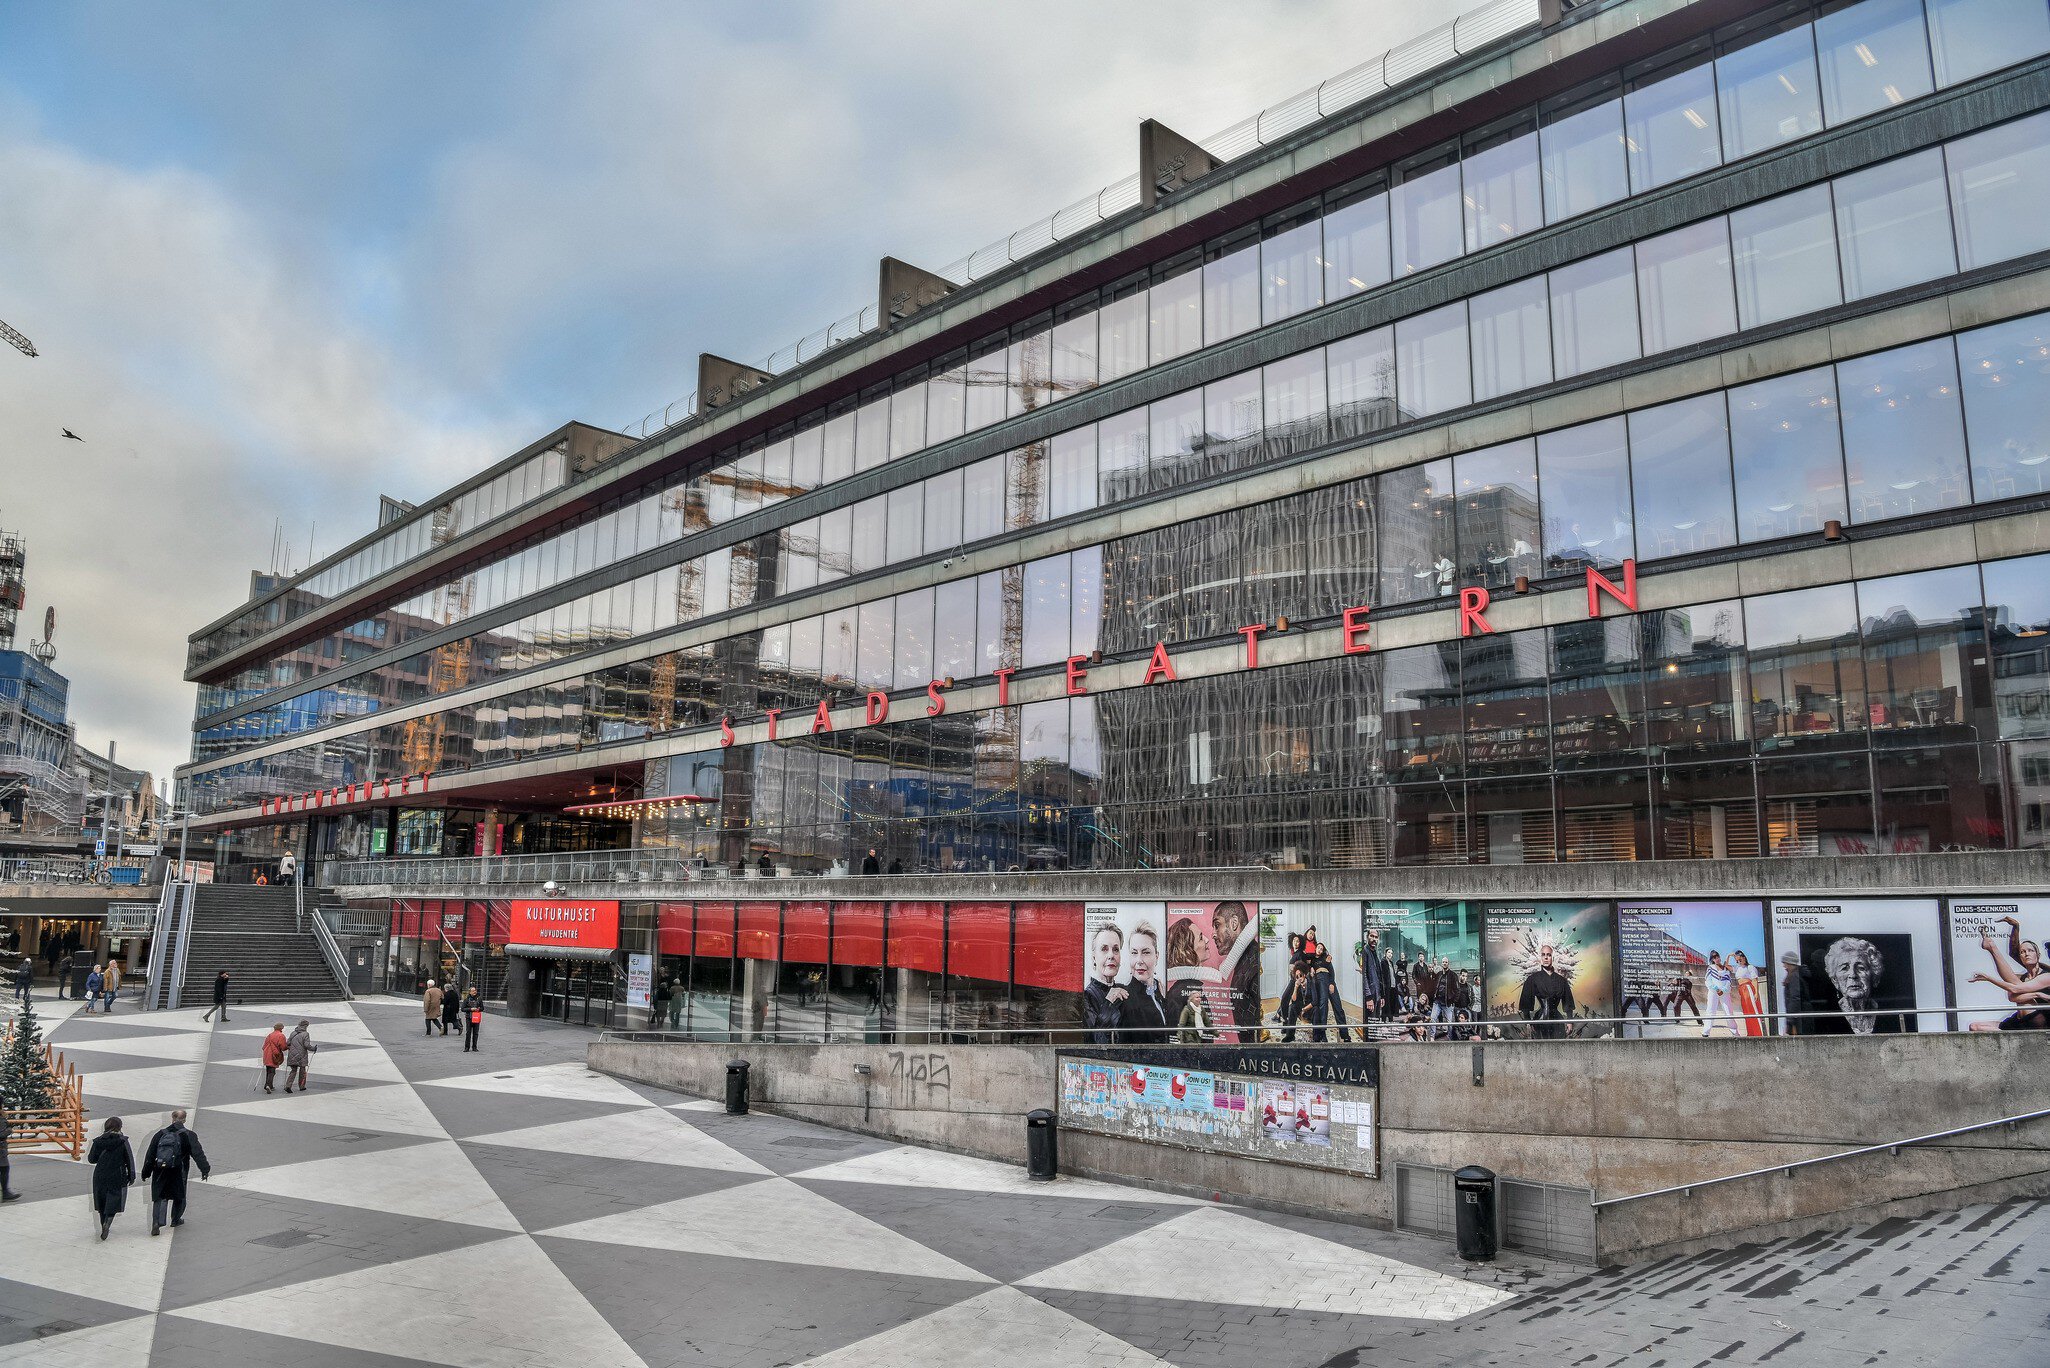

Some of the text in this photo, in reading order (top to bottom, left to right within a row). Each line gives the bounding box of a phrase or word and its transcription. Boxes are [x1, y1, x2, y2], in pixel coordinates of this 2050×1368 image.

[720, 558, 1638, 748] STADSTEATERN
[526, 907, 596, 922] KULTURHUSET
[540, 928, 578, 938] HUVUDENTRÉ
[1238, 1058, 1368, 1082] ANSLAGSTAVLA
